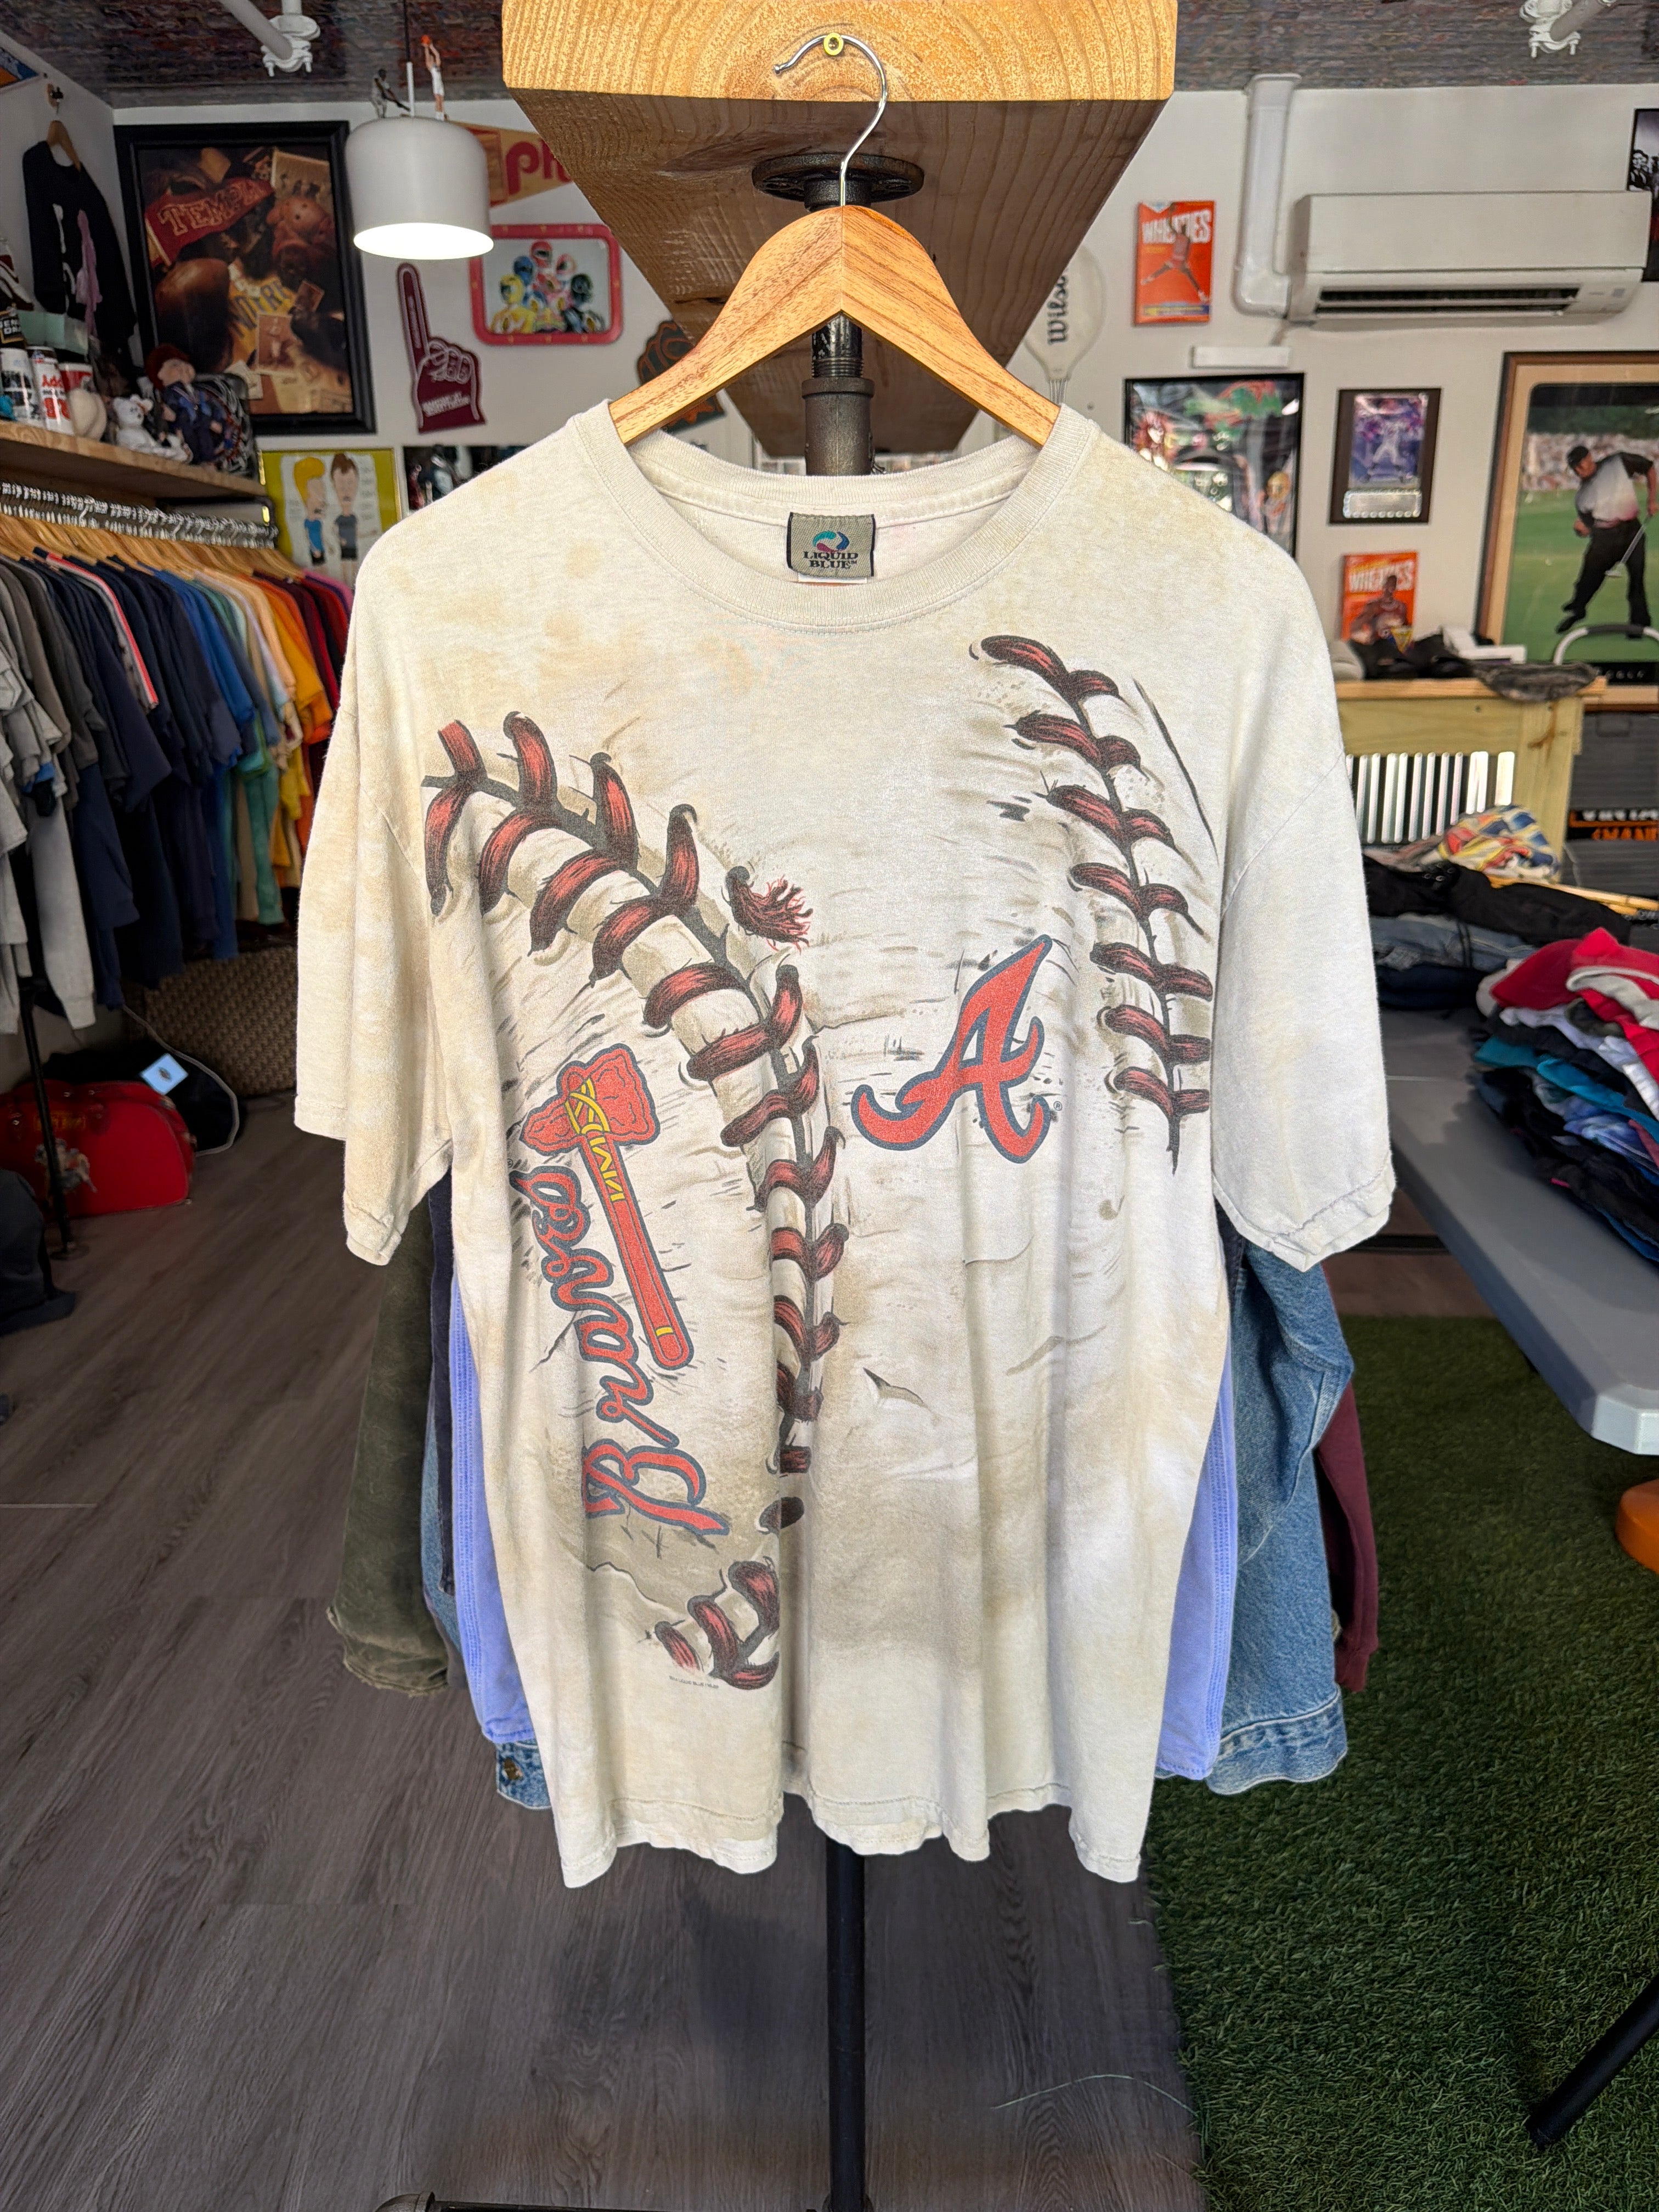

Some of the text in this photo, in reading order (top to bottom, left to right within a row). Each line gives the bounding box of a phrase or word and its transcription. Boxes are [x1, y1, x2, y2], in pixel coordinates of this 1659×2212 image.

[803, 551, 859, 562] LIQUID
[809, 560, 851, 569] BLUE
[851, 934, 1052, 1164] A
[509, 1165, 730, 1536] Braves
